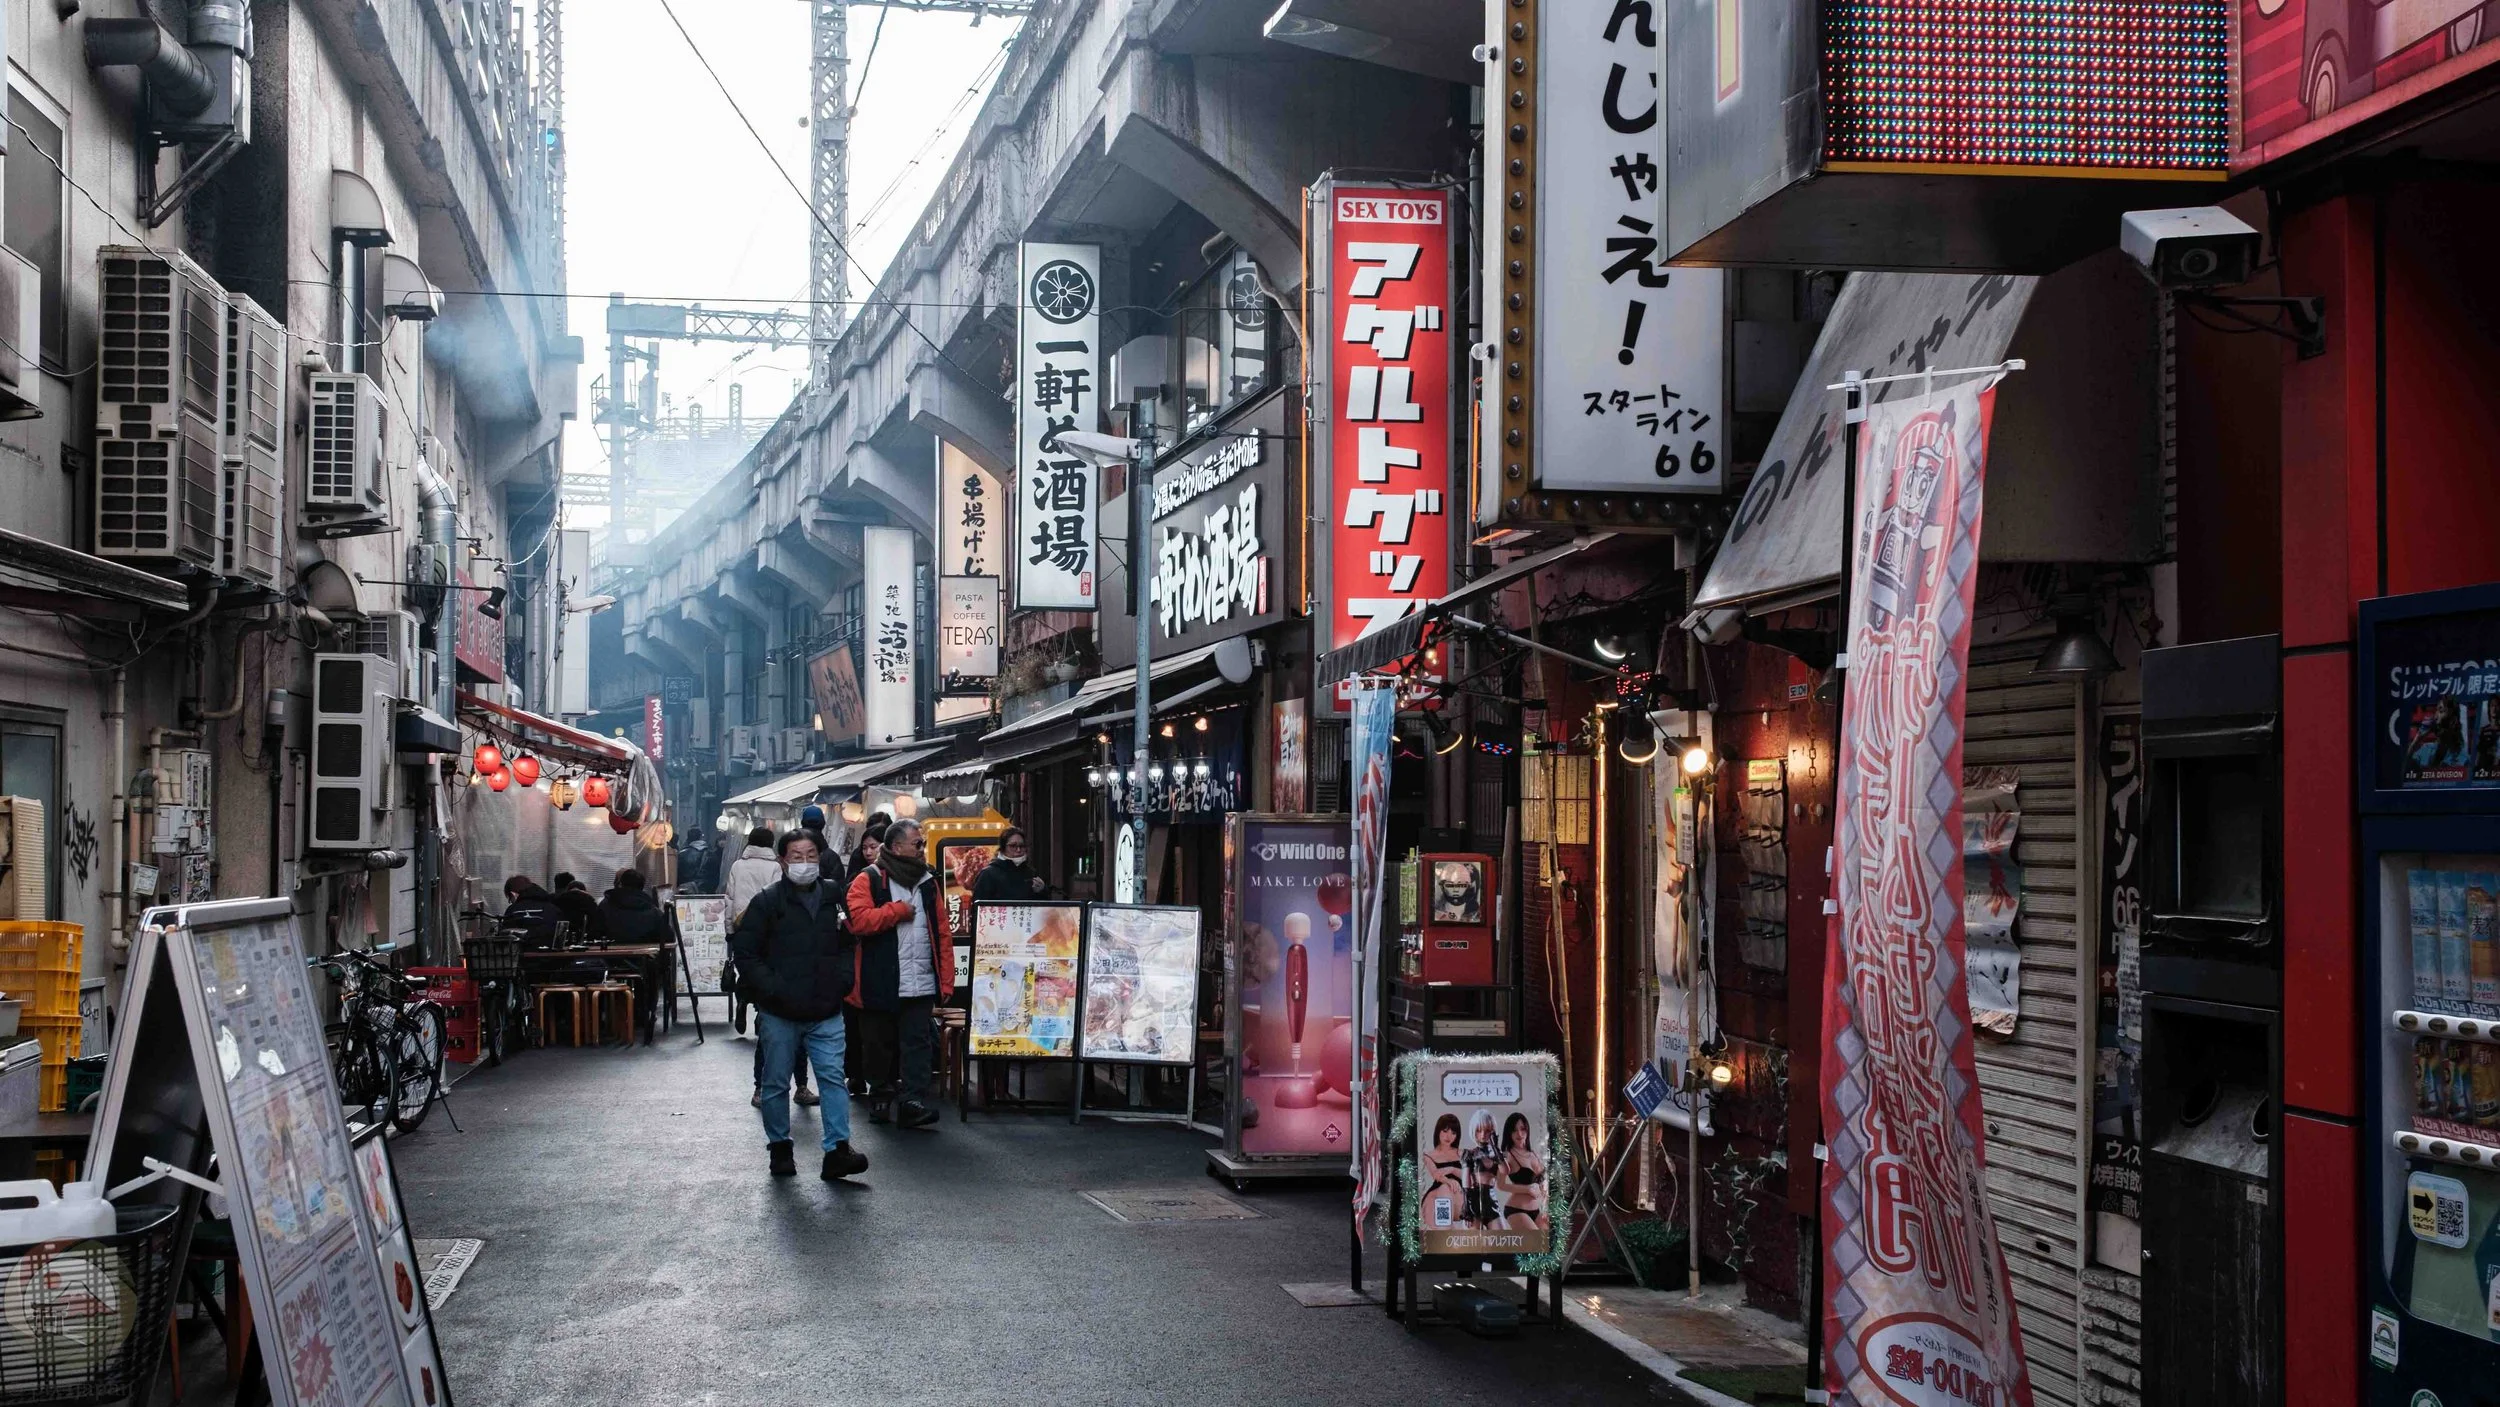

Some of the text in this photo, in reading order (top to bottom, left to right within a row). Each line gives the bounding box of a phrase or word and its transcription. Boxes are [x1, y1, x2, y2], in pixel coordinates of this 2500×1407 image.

[1342, 201, 1438, 220] SEX TOYS
[1583, 384, 1681, 417] スタート
[1636, 407, 1711, 436] ライン
[1654, 440, 1716, 478] 66
[955, 594, 984, 602] PASTA
[953, 612, 986, 620] COFFEE
[943, 625, 996, 646] TERAS
[2403, 677, 2465, 700] レッドブル
[2436, 769, 2464, 779] DIVISION
[2110, 725, 2142, 880] ライン
[1279, 843, 1345, 861] Wild One
[1251, 875, 1345, 888] MAKE LOVE
[948, 894, 961, 934] 旨カツ
[986, 1039, 1017, 1047] テキーラ
[1662, 1035, 1682, 1054] TENGA
[1450, 1086, 1513, 1097] オリエント工業
[1445, 1234, 1480, 1249] ORIENT
